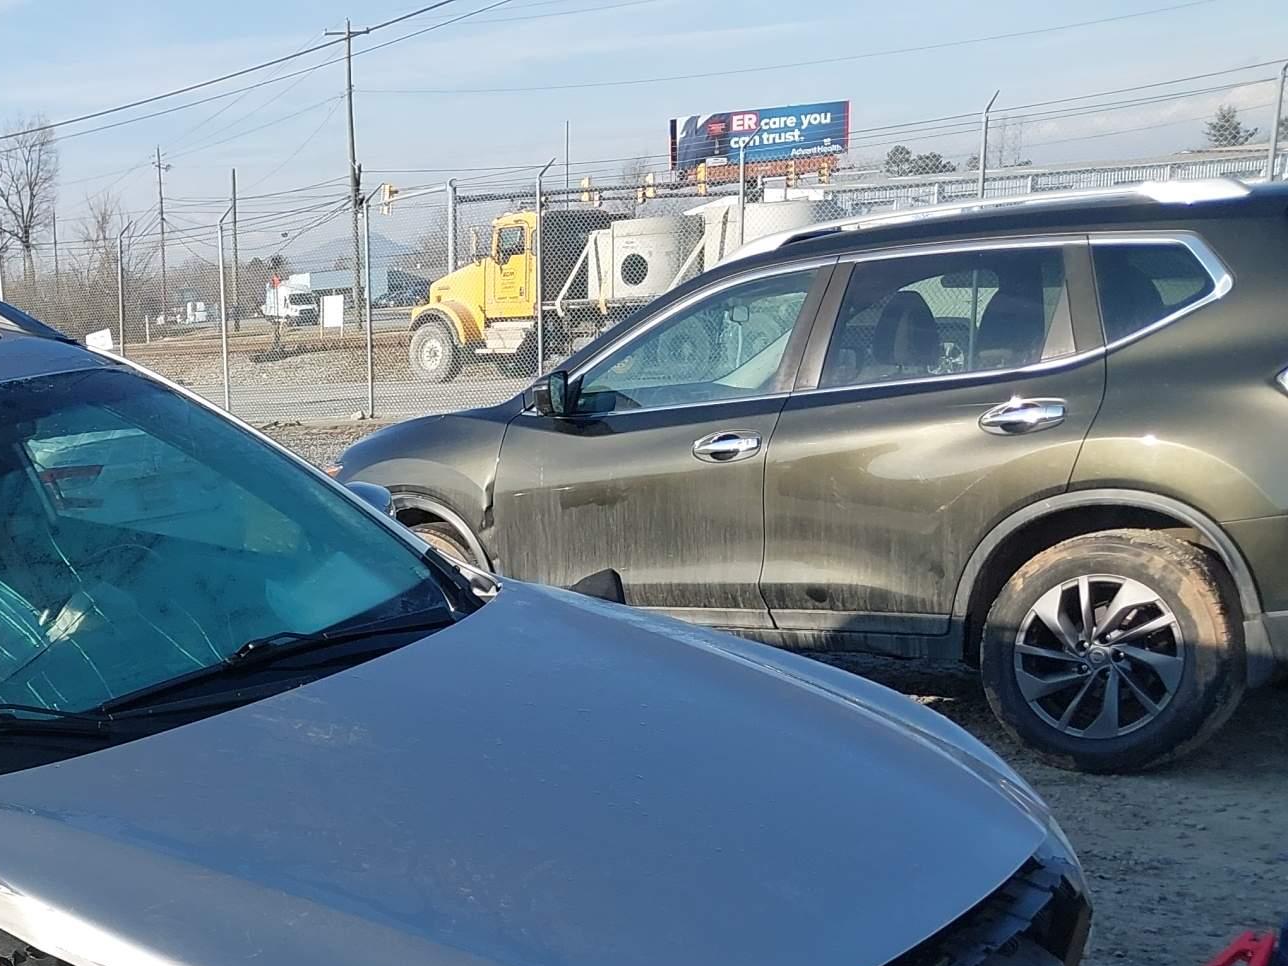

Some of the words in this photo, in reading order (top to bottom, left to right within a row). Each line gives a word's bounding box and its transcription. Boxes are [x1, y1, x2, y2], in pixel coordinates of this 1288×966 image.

[732, 114, 757, 131] ER
[760, 115, 796, 129] care
[800, 112, 832, 129] you
[730, 134, 759, 148] can
[762, 129, 804, 144] trust.
